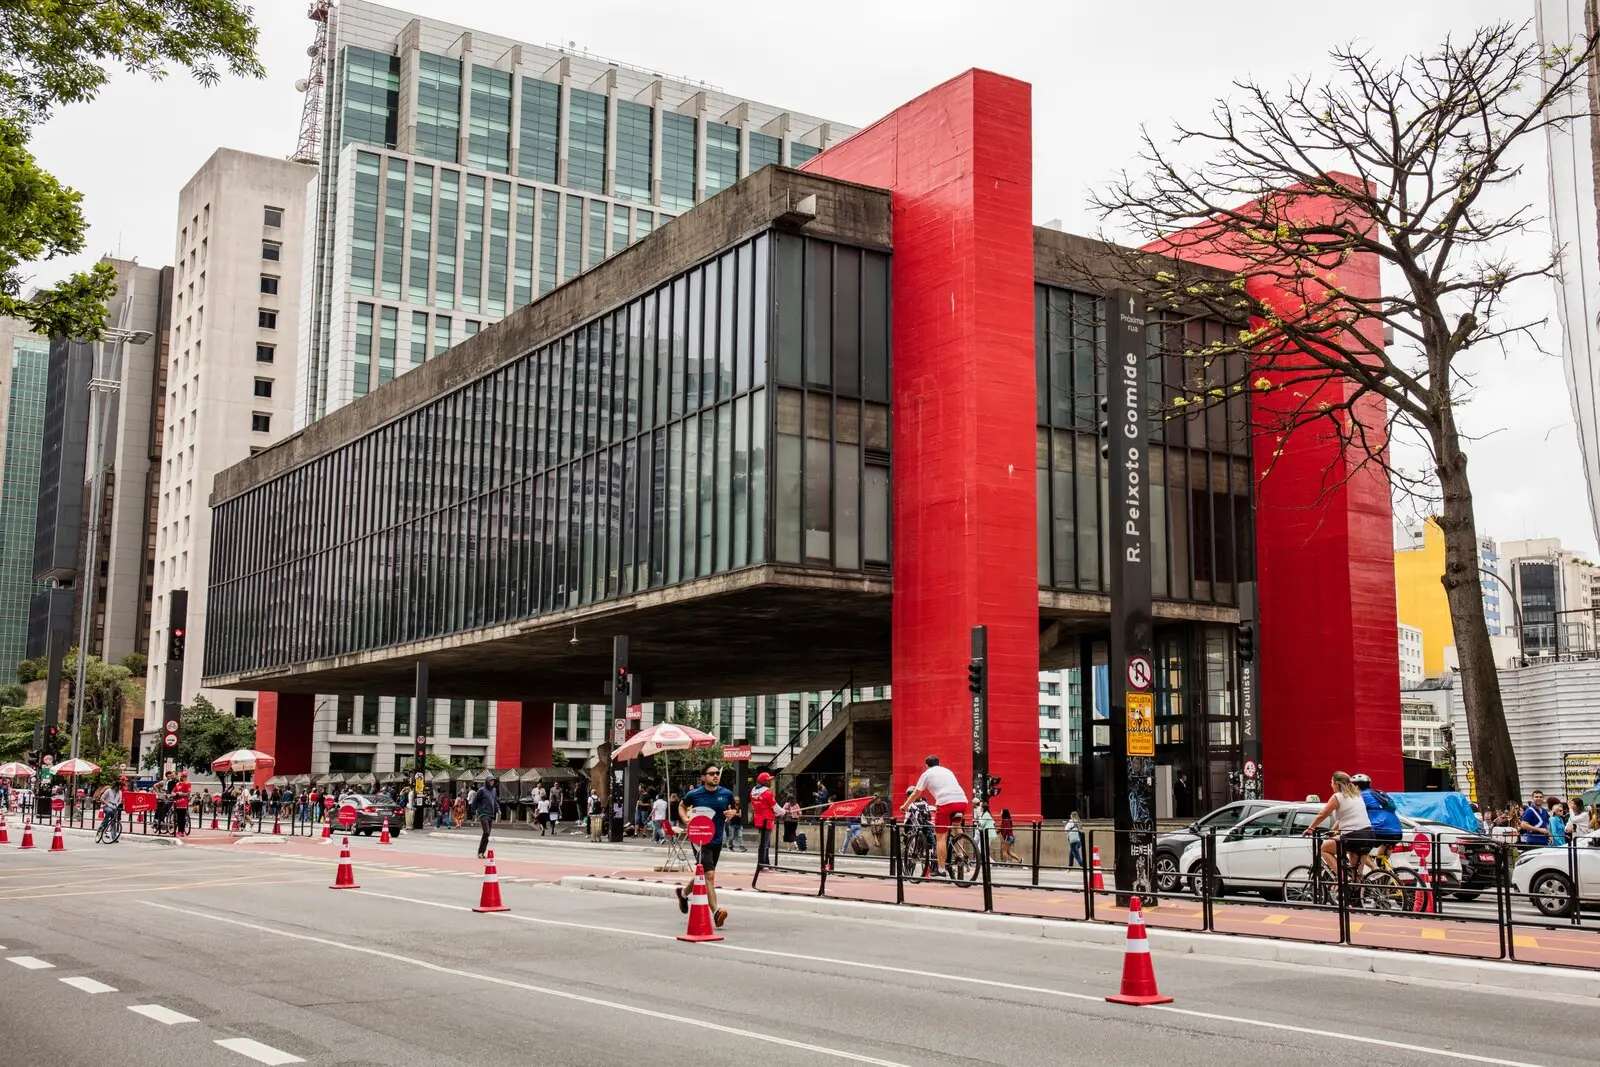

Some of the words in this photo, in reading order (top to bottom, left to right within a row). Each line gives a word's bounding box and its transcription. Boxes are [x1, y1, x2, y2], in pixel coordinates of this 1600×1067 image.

[1120, 313, 1144, 325] Próxima
[1124, 352, 1138, 439] Gomide
[1125, 447, 1139, 536] Peixoto
[1127, 543, 1140, 562] R.
